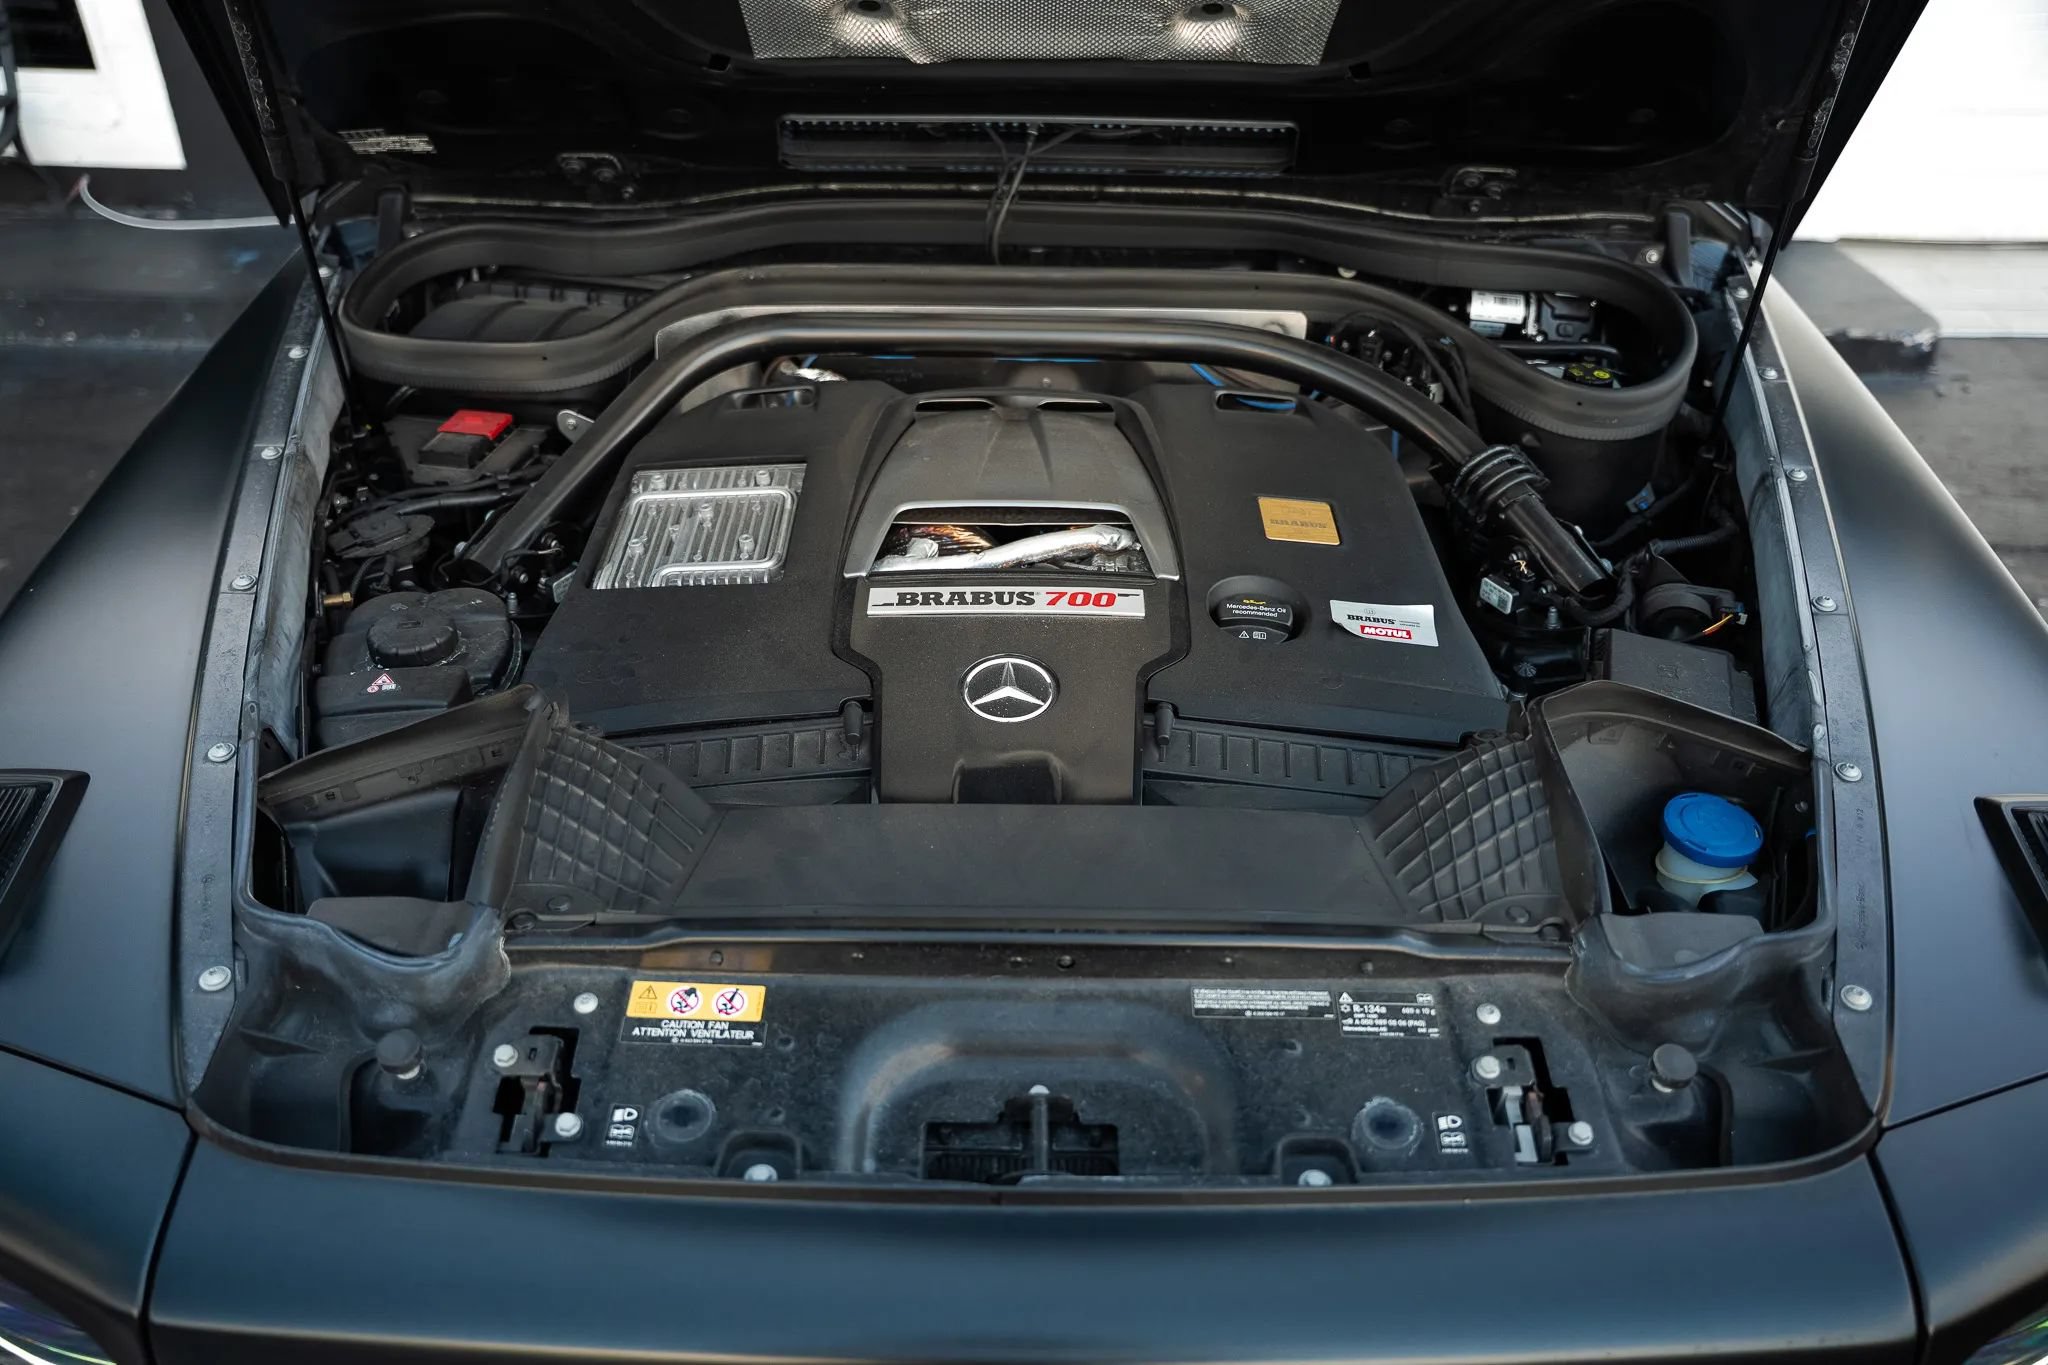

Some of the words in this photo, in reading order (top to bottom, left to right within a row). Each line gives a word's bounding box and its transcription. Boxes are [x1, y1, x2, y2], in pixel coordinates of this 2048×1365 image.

[895, 591, 1036, 607] BRABUS
[1045, 591, 1118, 608] 700
[1346, 614, 1395, 625] BRABUS
[1363, 626, 1410, 639] MOTUL
[661, 1019, 705, 1030] CAUTION
[708, 1020, 730, 1030] FAN
[632, 1027, 688, 1038] ATTENTION
[690, 1028, 754, 1040] VENTILATEUR
